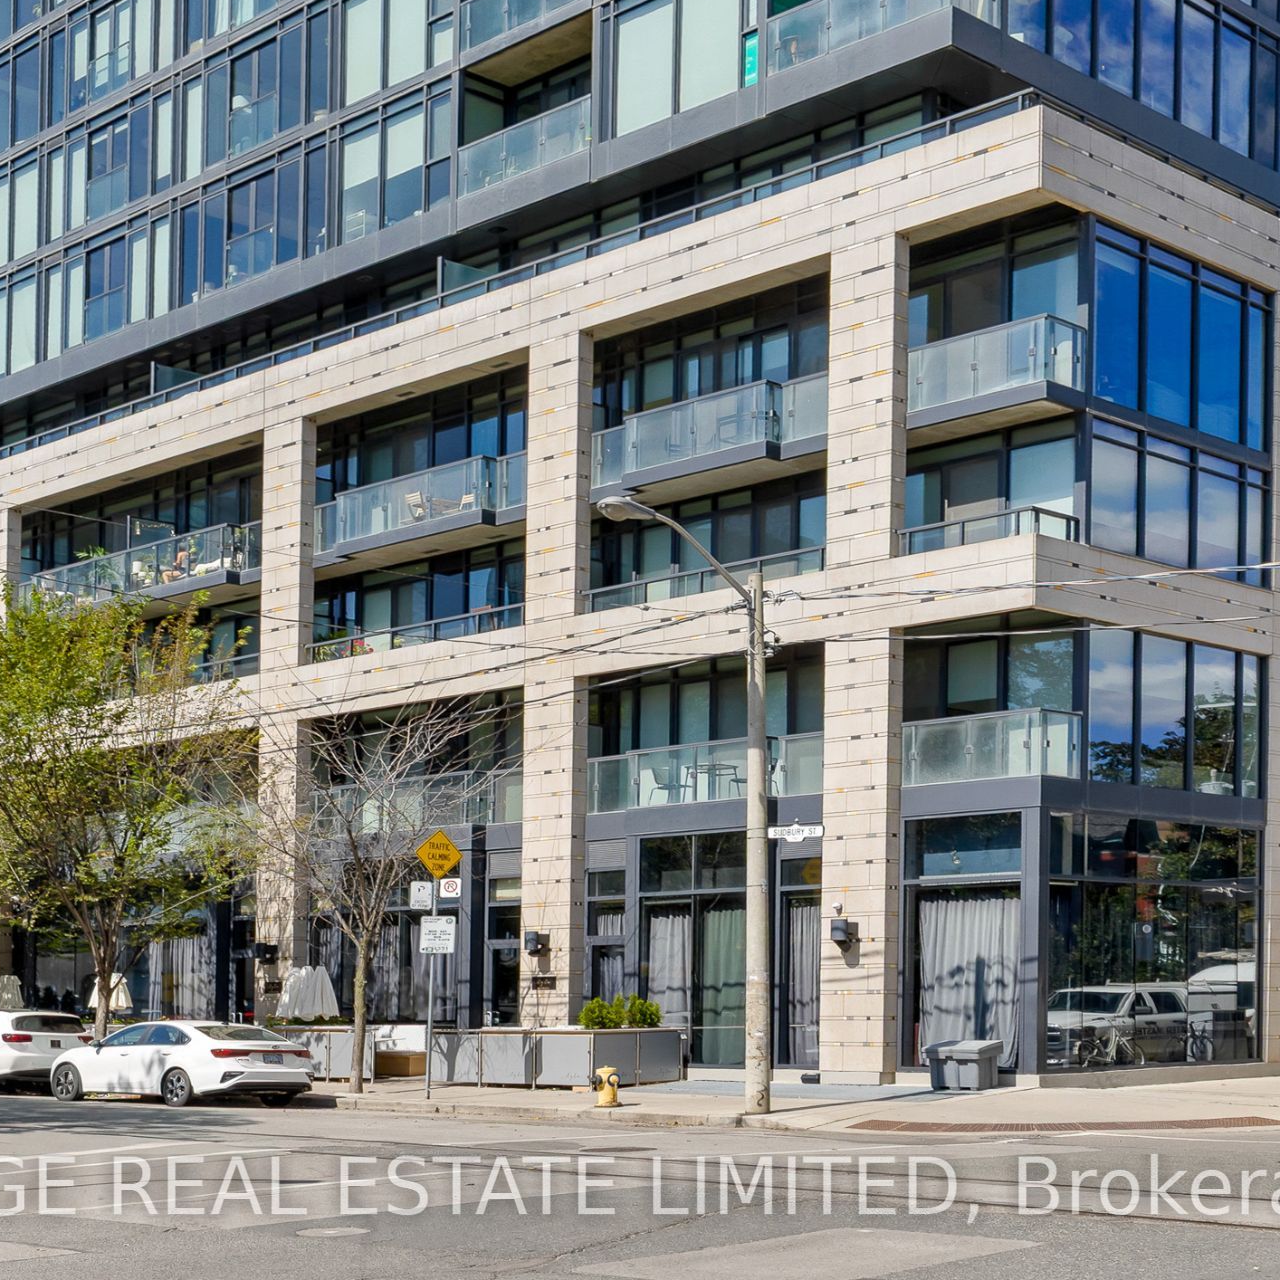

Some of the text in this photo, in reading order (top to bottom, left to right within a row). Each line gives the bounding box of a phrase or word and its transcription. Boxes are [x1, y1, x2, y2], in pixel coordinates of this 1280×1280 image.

[773, 827, 817, 837] SUDBURY ST
[428, 842, 450, 851] TRAFFIC
[427, 852, 451, 861] CALMING
[432, 863, 446, 871] ZONE
